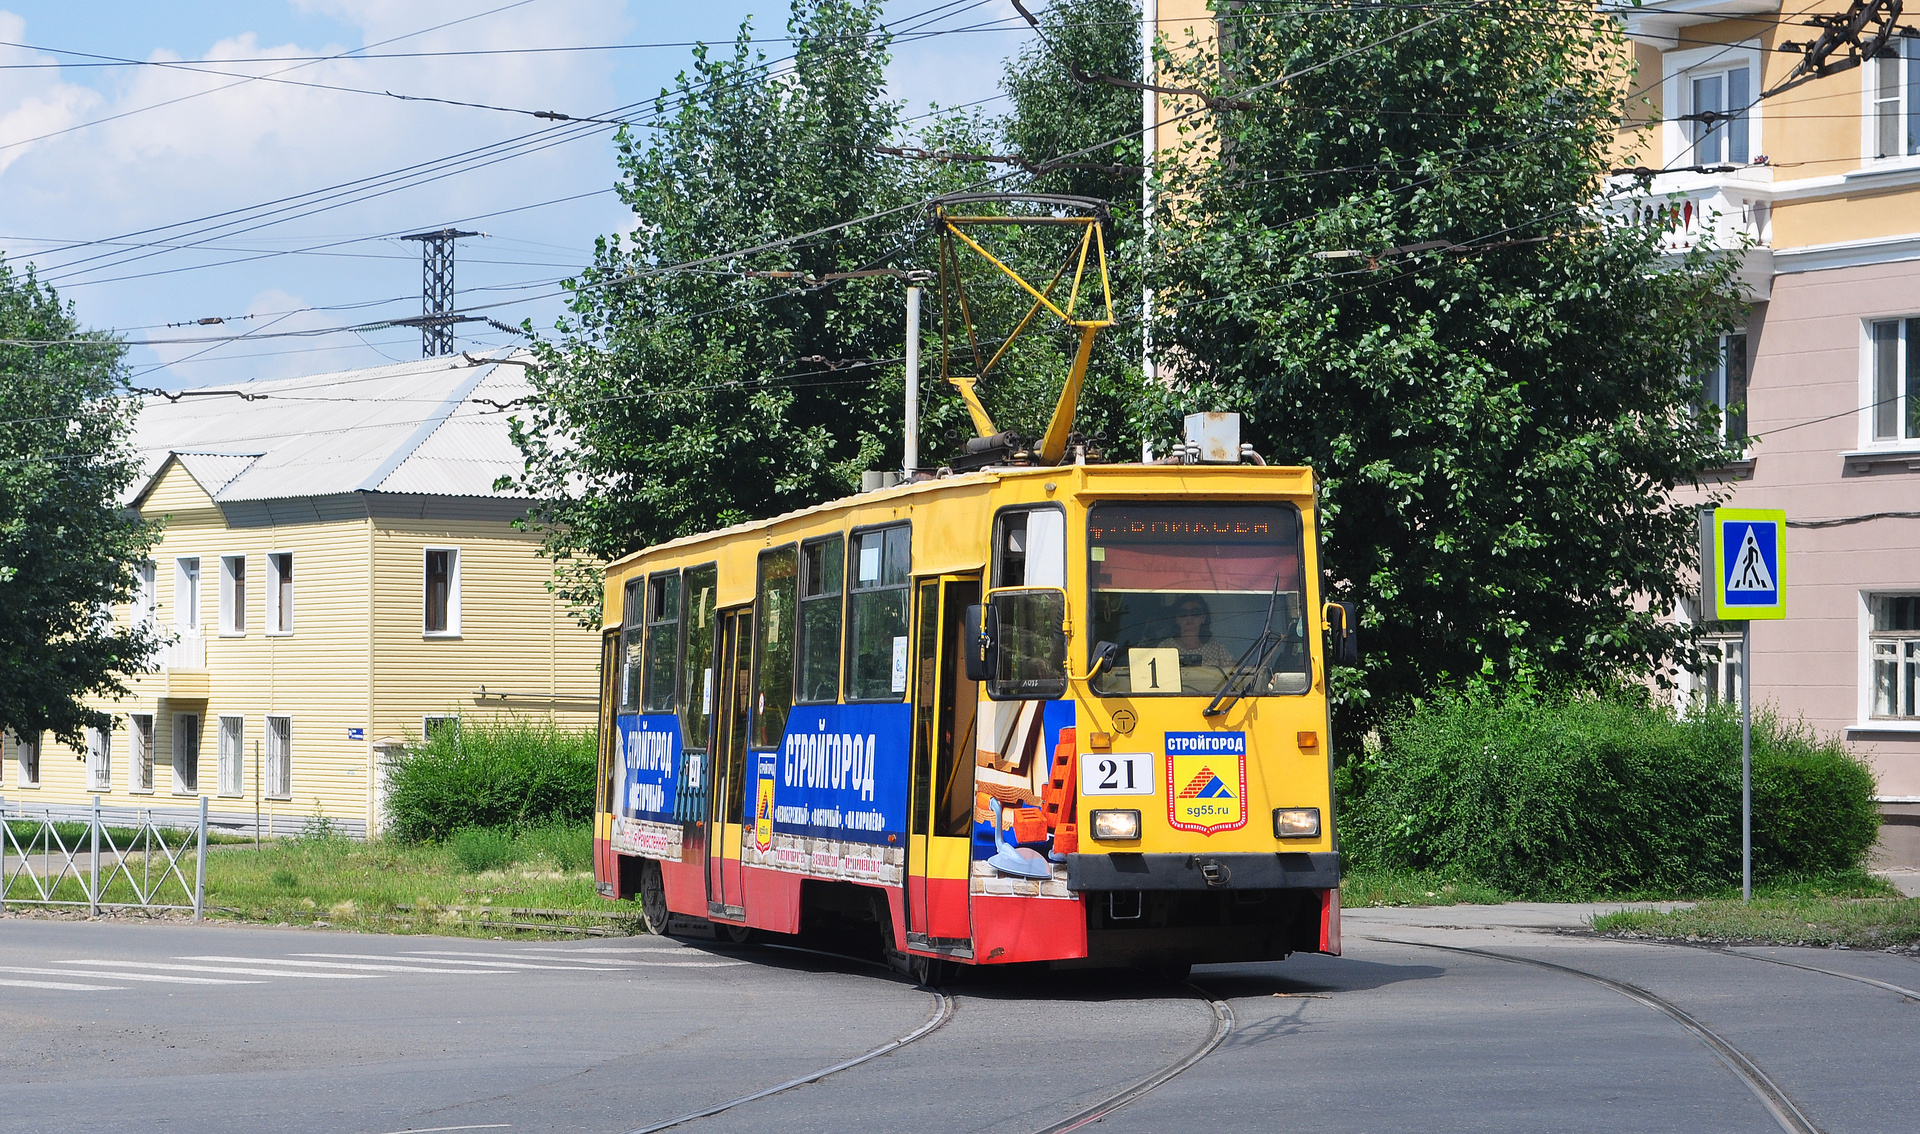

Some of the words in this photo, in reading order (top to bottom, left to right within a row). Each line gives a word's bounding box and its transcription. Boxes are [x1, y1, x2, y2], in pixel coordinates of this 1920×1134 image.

[1147, 657, 1160, 689] 1
[626, 720, 673, 779] СТРОЙГОРОД
[1167, 734, 1244, 752] СТРОЙГОРОД
[784, 718, 876, 802] СТРОЙГОРОД
[1098, 759, 1137, 789] 21
[1186, 805, 1229, 818] sg55.ru
